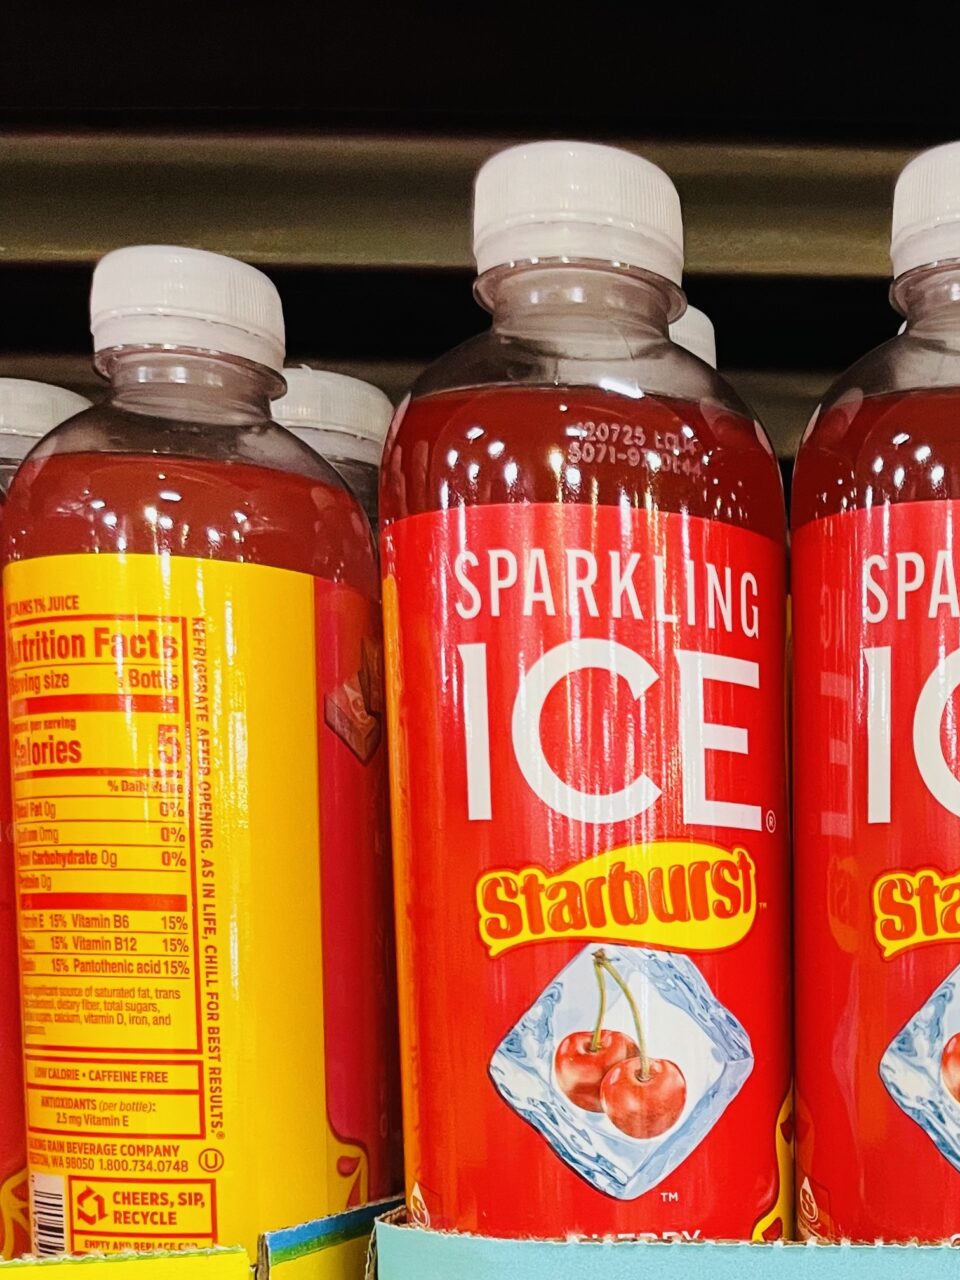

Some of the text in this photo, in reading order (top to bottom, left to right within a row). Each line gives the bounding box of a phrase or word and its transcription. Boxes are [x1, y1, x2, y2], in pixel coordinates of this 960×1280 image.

[454, 548, 759, 639] SPARKLING
[47, 596, 79, 612] JUICE
[94, 627, 178, 659] Facts
[44, 669, 178, 690] size Bottle
[458, 638, 763, 832] ICE
[158, 724, 182, 764] 5
[159, 802, 184, 818] 0%
[160, 827, 186, 842] 0%
[32, 850, 98, 868] Carbohydrate
[101, 850, 117, 868] 0g
[161, 851, 187, 866] 0%
[202, 857, 214, 878] AS
[202, 887, 215, 899] IN
[481, 851, 753, 939] Starburst
[72, 914, 110, 928] Vitamin
[113, 914, 130, 929] B6
[161, 916, 188, 930] 15%
[202, 902, 216, 940] LIFE,
[72, 937, 112, 951] Vitamin
[114, 937, 137, 952] B12
[162, 938, 189, 953] 15%
[73, 958, 134, 974] Pantothenic
[136, 959, 161, 975] acid
[163, 960, 190, 975] 15%
[204, 944, 218, 988] CHILL
[95, 986, 135, 998] saturated
[155, 988, 181, 1000] trans
[103, 1000, 123, 1011] total
[125, 1002, 160, 1014] sugars,
[206, 992, 219, 1021] FOR
[84, 1013, 114, 1025] vitamin
[128, 1014, 150, 1027] iron,
[152, 1014, 171, 1026] and
[207, 1026, 221, 1062] BEST
[48, 1068, 168, 1083] CALORIE CAFFEINE FREE
[41, 1096, 97, 1110] ANTIOXIDANTS
[98, 1100, 117, 1113] (per
[69, 1115, 81, 1127] mg
[84, 1114, 120, 1127] Vitamin
[122, 1115, 129, 1126] E
[67, 1142, 117, 1156] BEVERAGE
[120, 1144, 180, 1157] COMPANY
[66, 1157, 94, 1170] 98050
[99, 1158, 189, 1172] 1.800.734.0748
[112, 1191, 205, 1208] CHEERS, SIP,
[113, 1210, 177, 1225] RECYCLE
